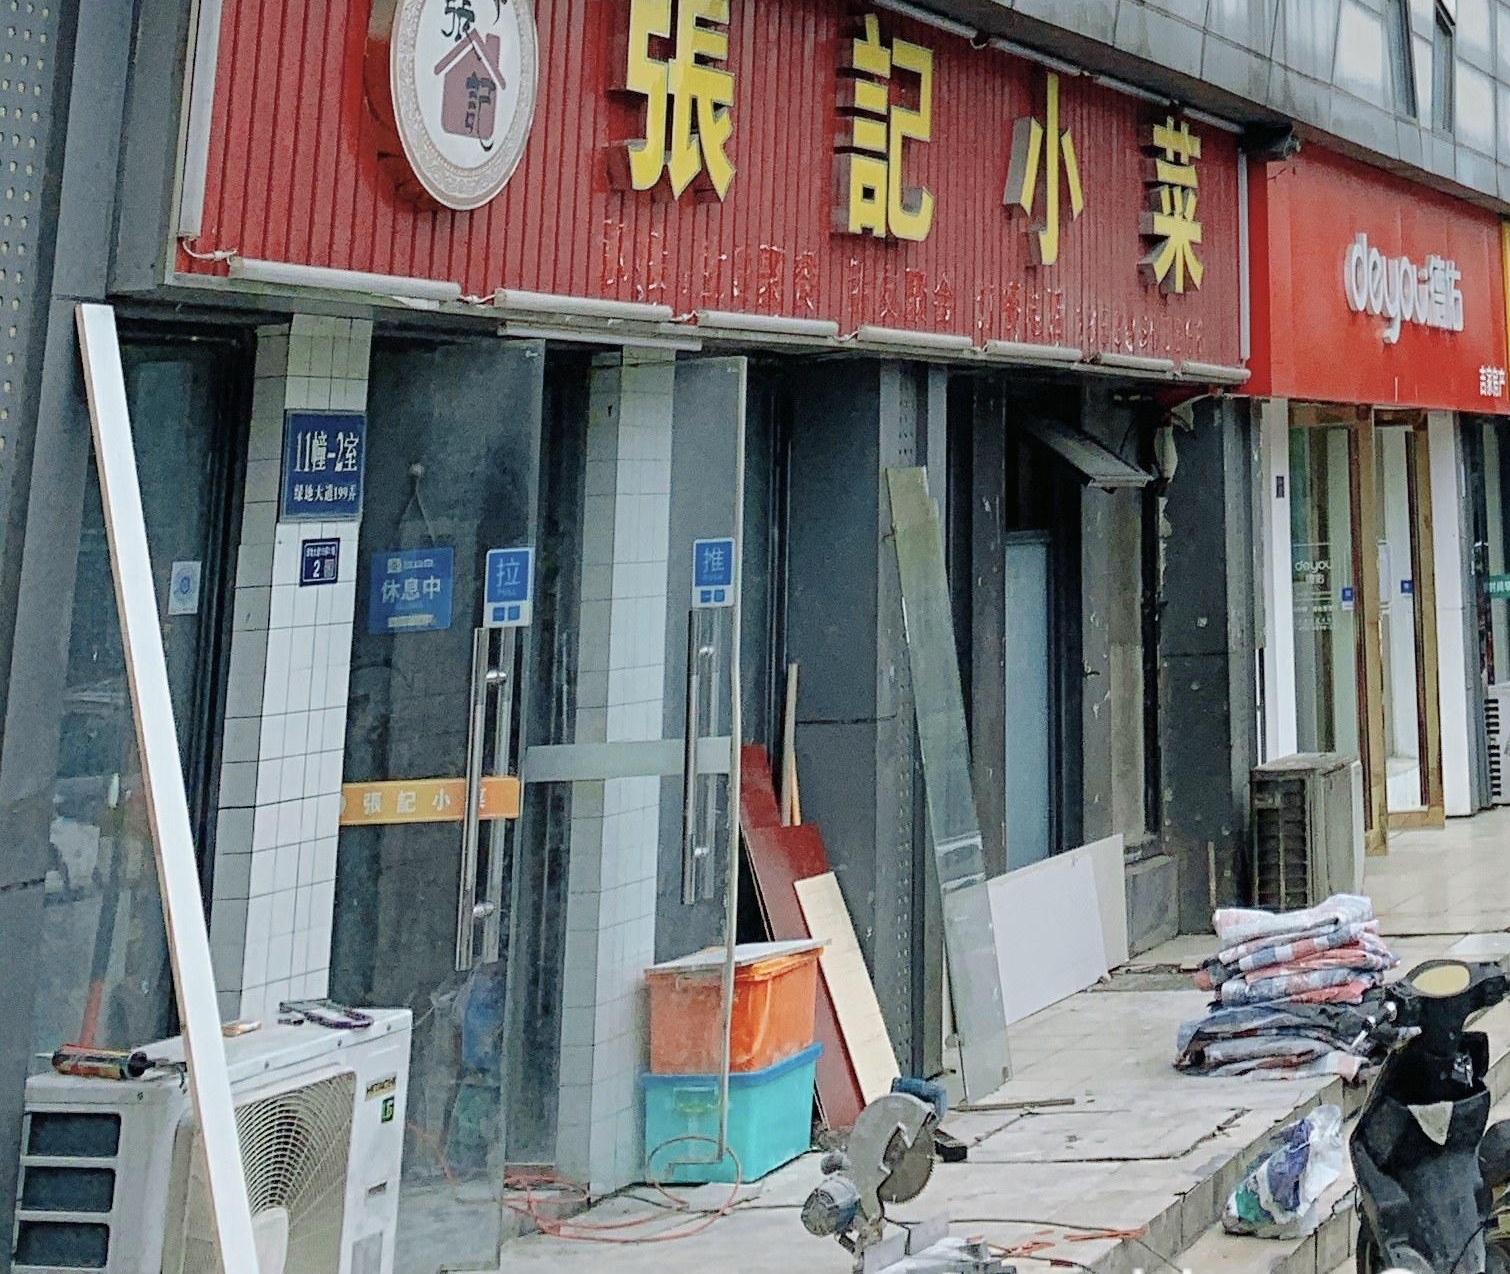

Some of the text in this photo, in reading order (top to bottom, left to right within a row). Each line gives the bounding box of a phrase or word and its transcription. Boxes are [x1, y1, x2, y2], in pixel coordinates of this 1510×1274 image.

[294, 430, 360, 473] 11幢-2室
[293, 483, 358, 503] 绿地大道199弄
[312, 559, 322, 578] 2
[495, 557, 521, 588] 拉
[701, 547, 726, 574] 推
[381, 574, 441, 604] 休息中
